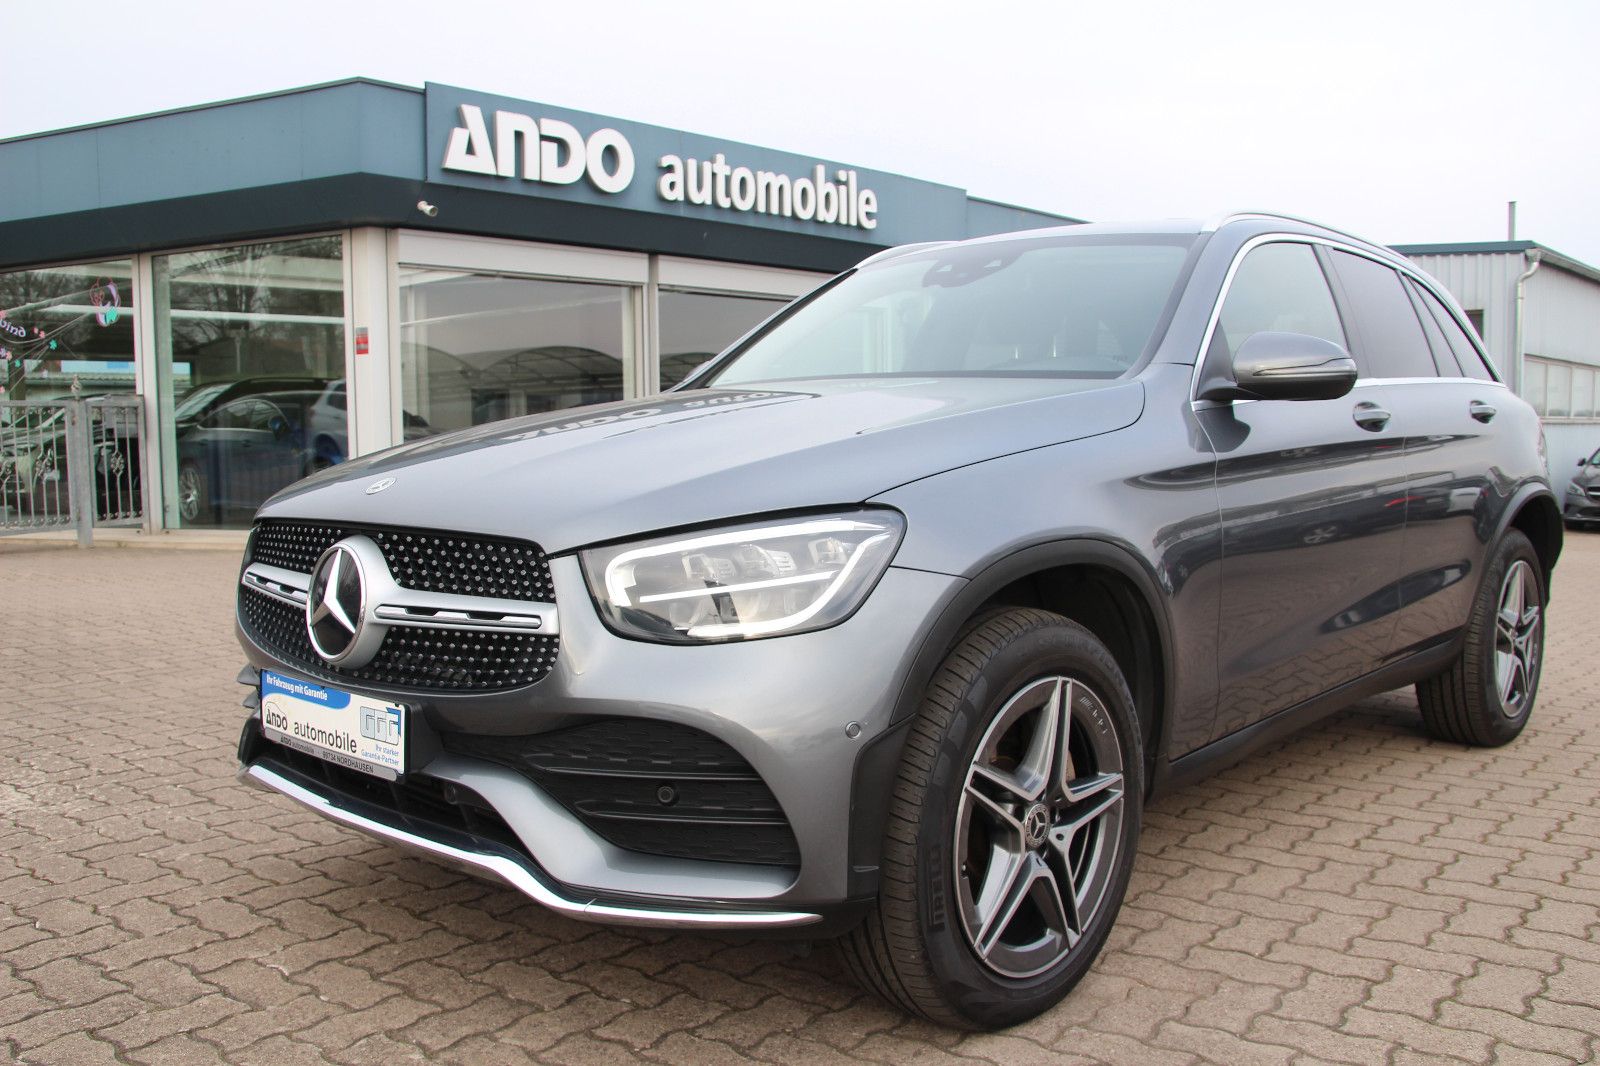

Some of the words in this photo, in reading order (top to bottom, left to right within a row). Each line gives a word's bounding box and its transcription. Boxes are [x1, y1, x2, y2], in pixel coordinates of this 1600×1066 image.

[442, 104, 635, 194] ANDO
[657, 153, 877, 230] automobile
[294, 684, 304, 695] mit
[303, 685, 328, 701] Garantie
[266, 708, 288, 731] ANDO
[294, 720, 357, 754] automobile
[336, 754, 374, 773] NORDHAUSEN
